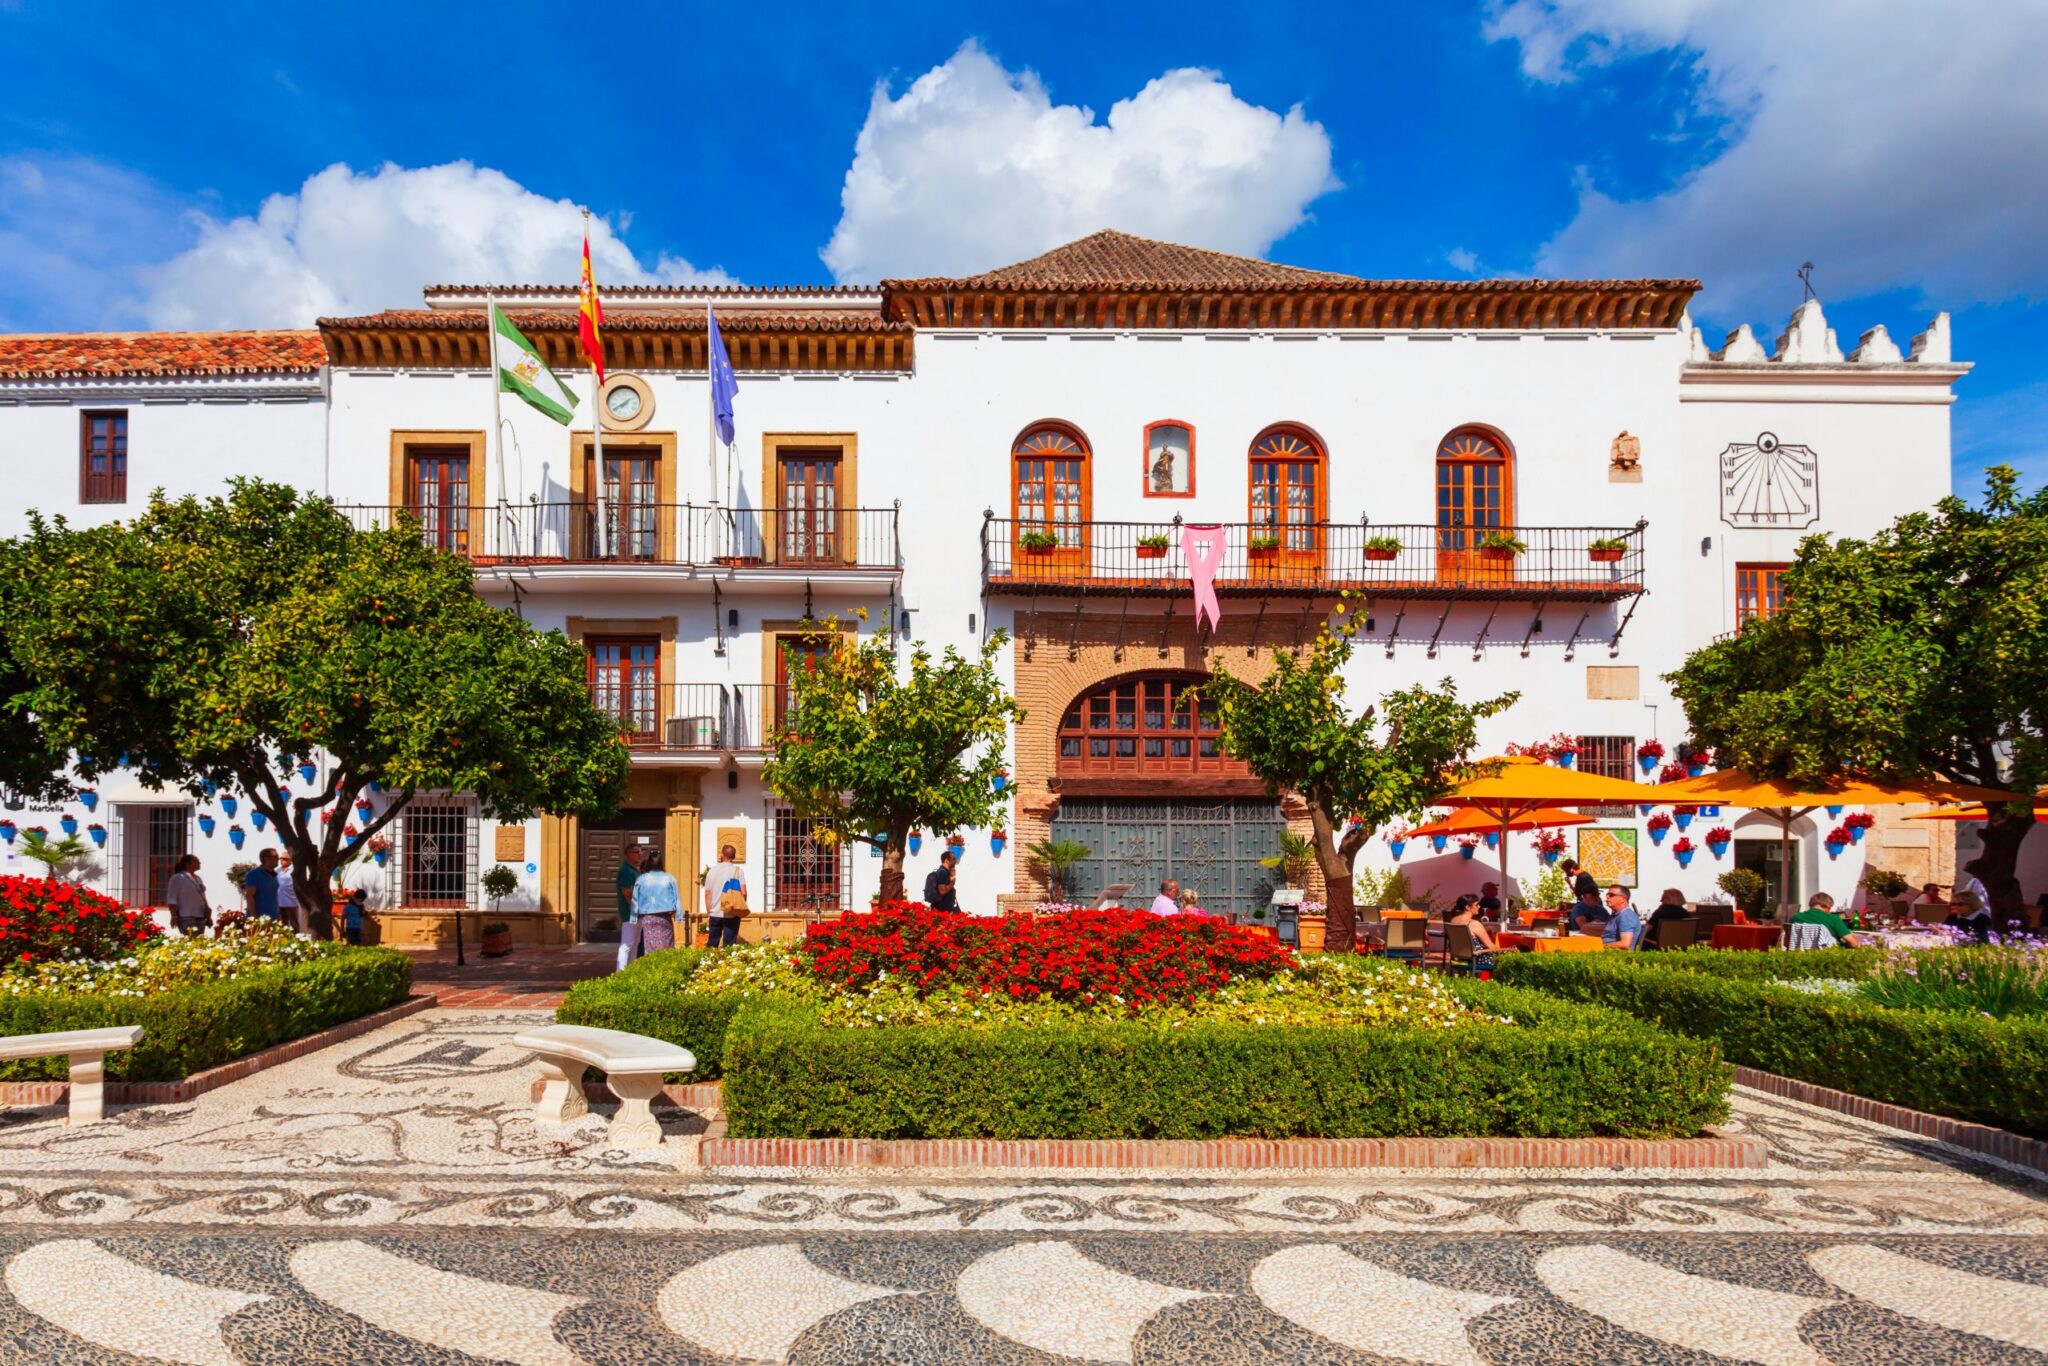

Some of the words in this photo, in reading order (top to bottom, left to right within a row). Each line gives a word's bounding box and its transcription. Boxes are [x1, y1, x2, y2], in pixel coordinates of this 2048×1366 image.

[1731, 446, 1739, 454] VI
[1723, 457, 1735, 466] VII
[1803, 463, 1814, 471] IIII
[1803, 478, 1812, 487] III
[1726, 487, 1735, 496] IX
[1766, 514, 1777, 523] XII
[29, 804, 64, 812] Marbella
